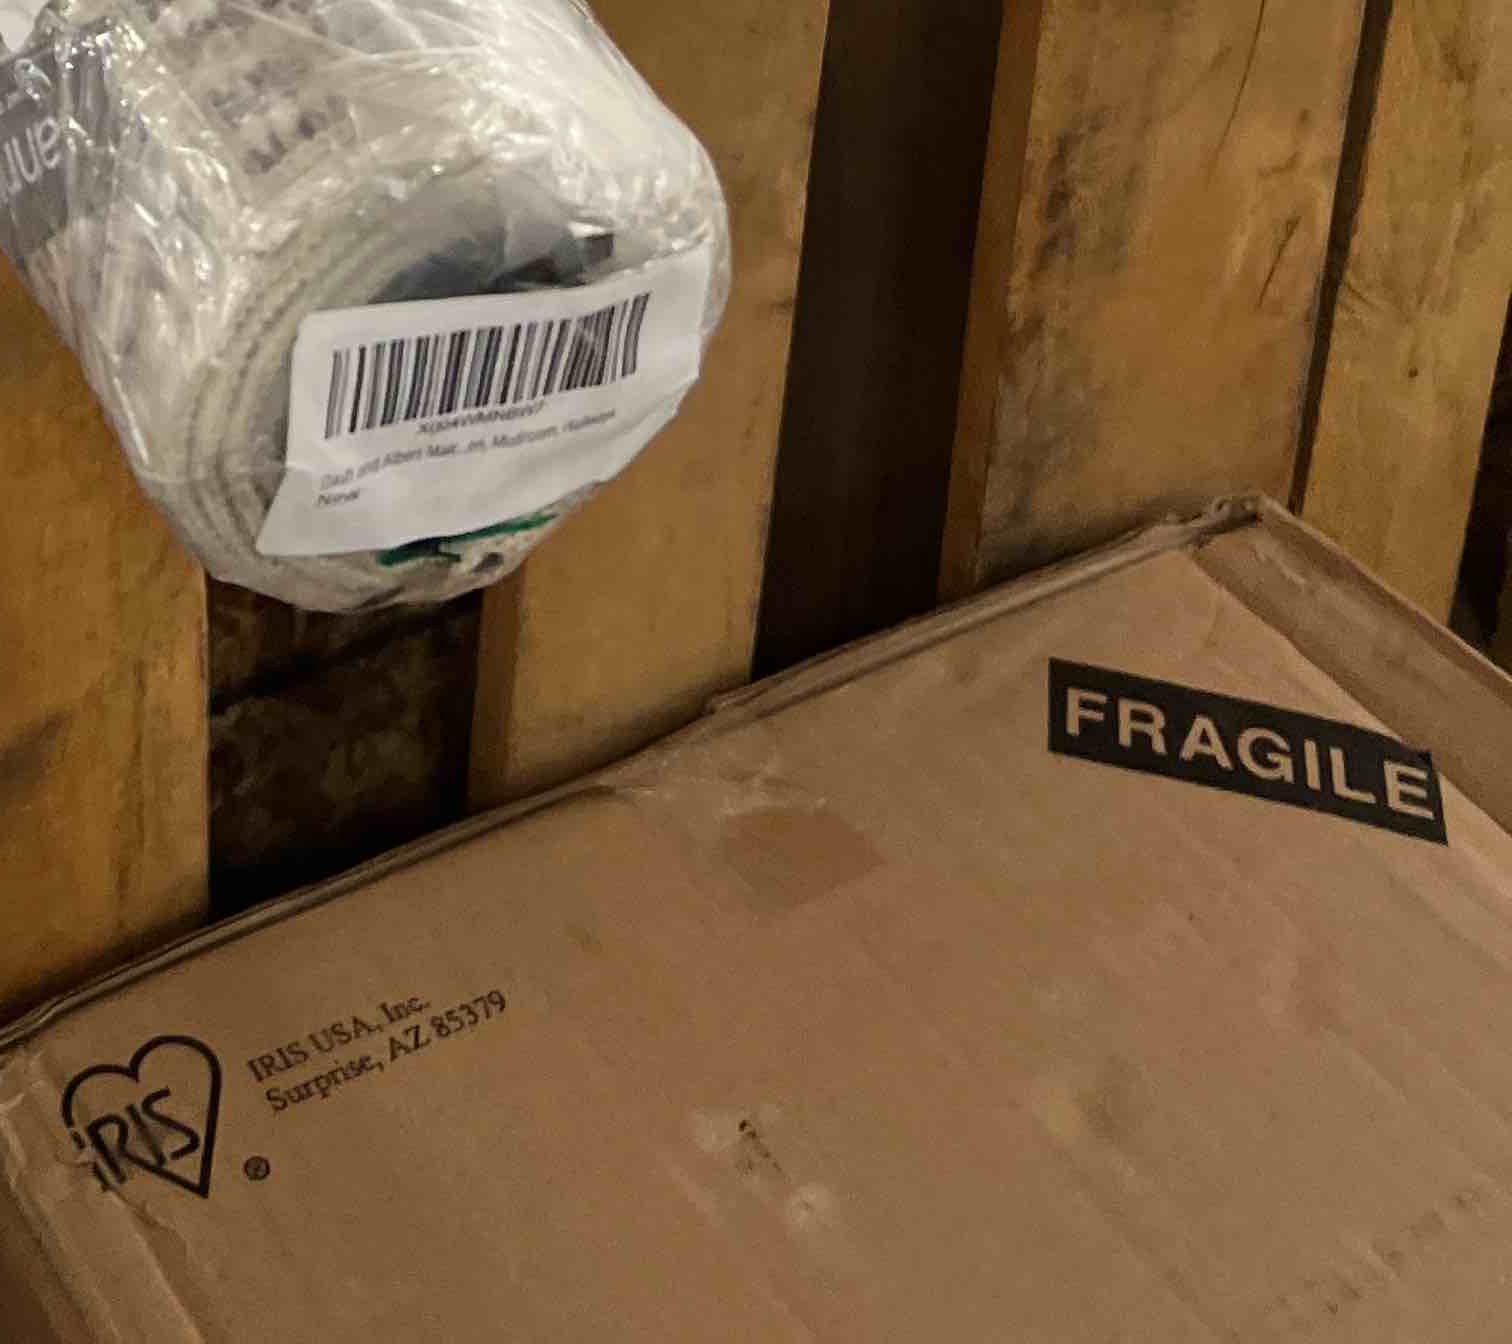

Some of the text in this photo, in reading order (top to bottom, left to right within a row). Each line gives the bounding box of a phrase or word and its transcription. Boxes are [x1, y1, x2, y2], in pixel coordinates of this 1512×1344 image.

[356, 456, 381, 479] and
[383, 448, 423, 466] Albert
[1065, 687, 1434, 820] FRAGILE
[246, 993, 431, 1082] IRIS USA, Inc.
[265, 988, 507, 1111] Surprise, AZ 85379
